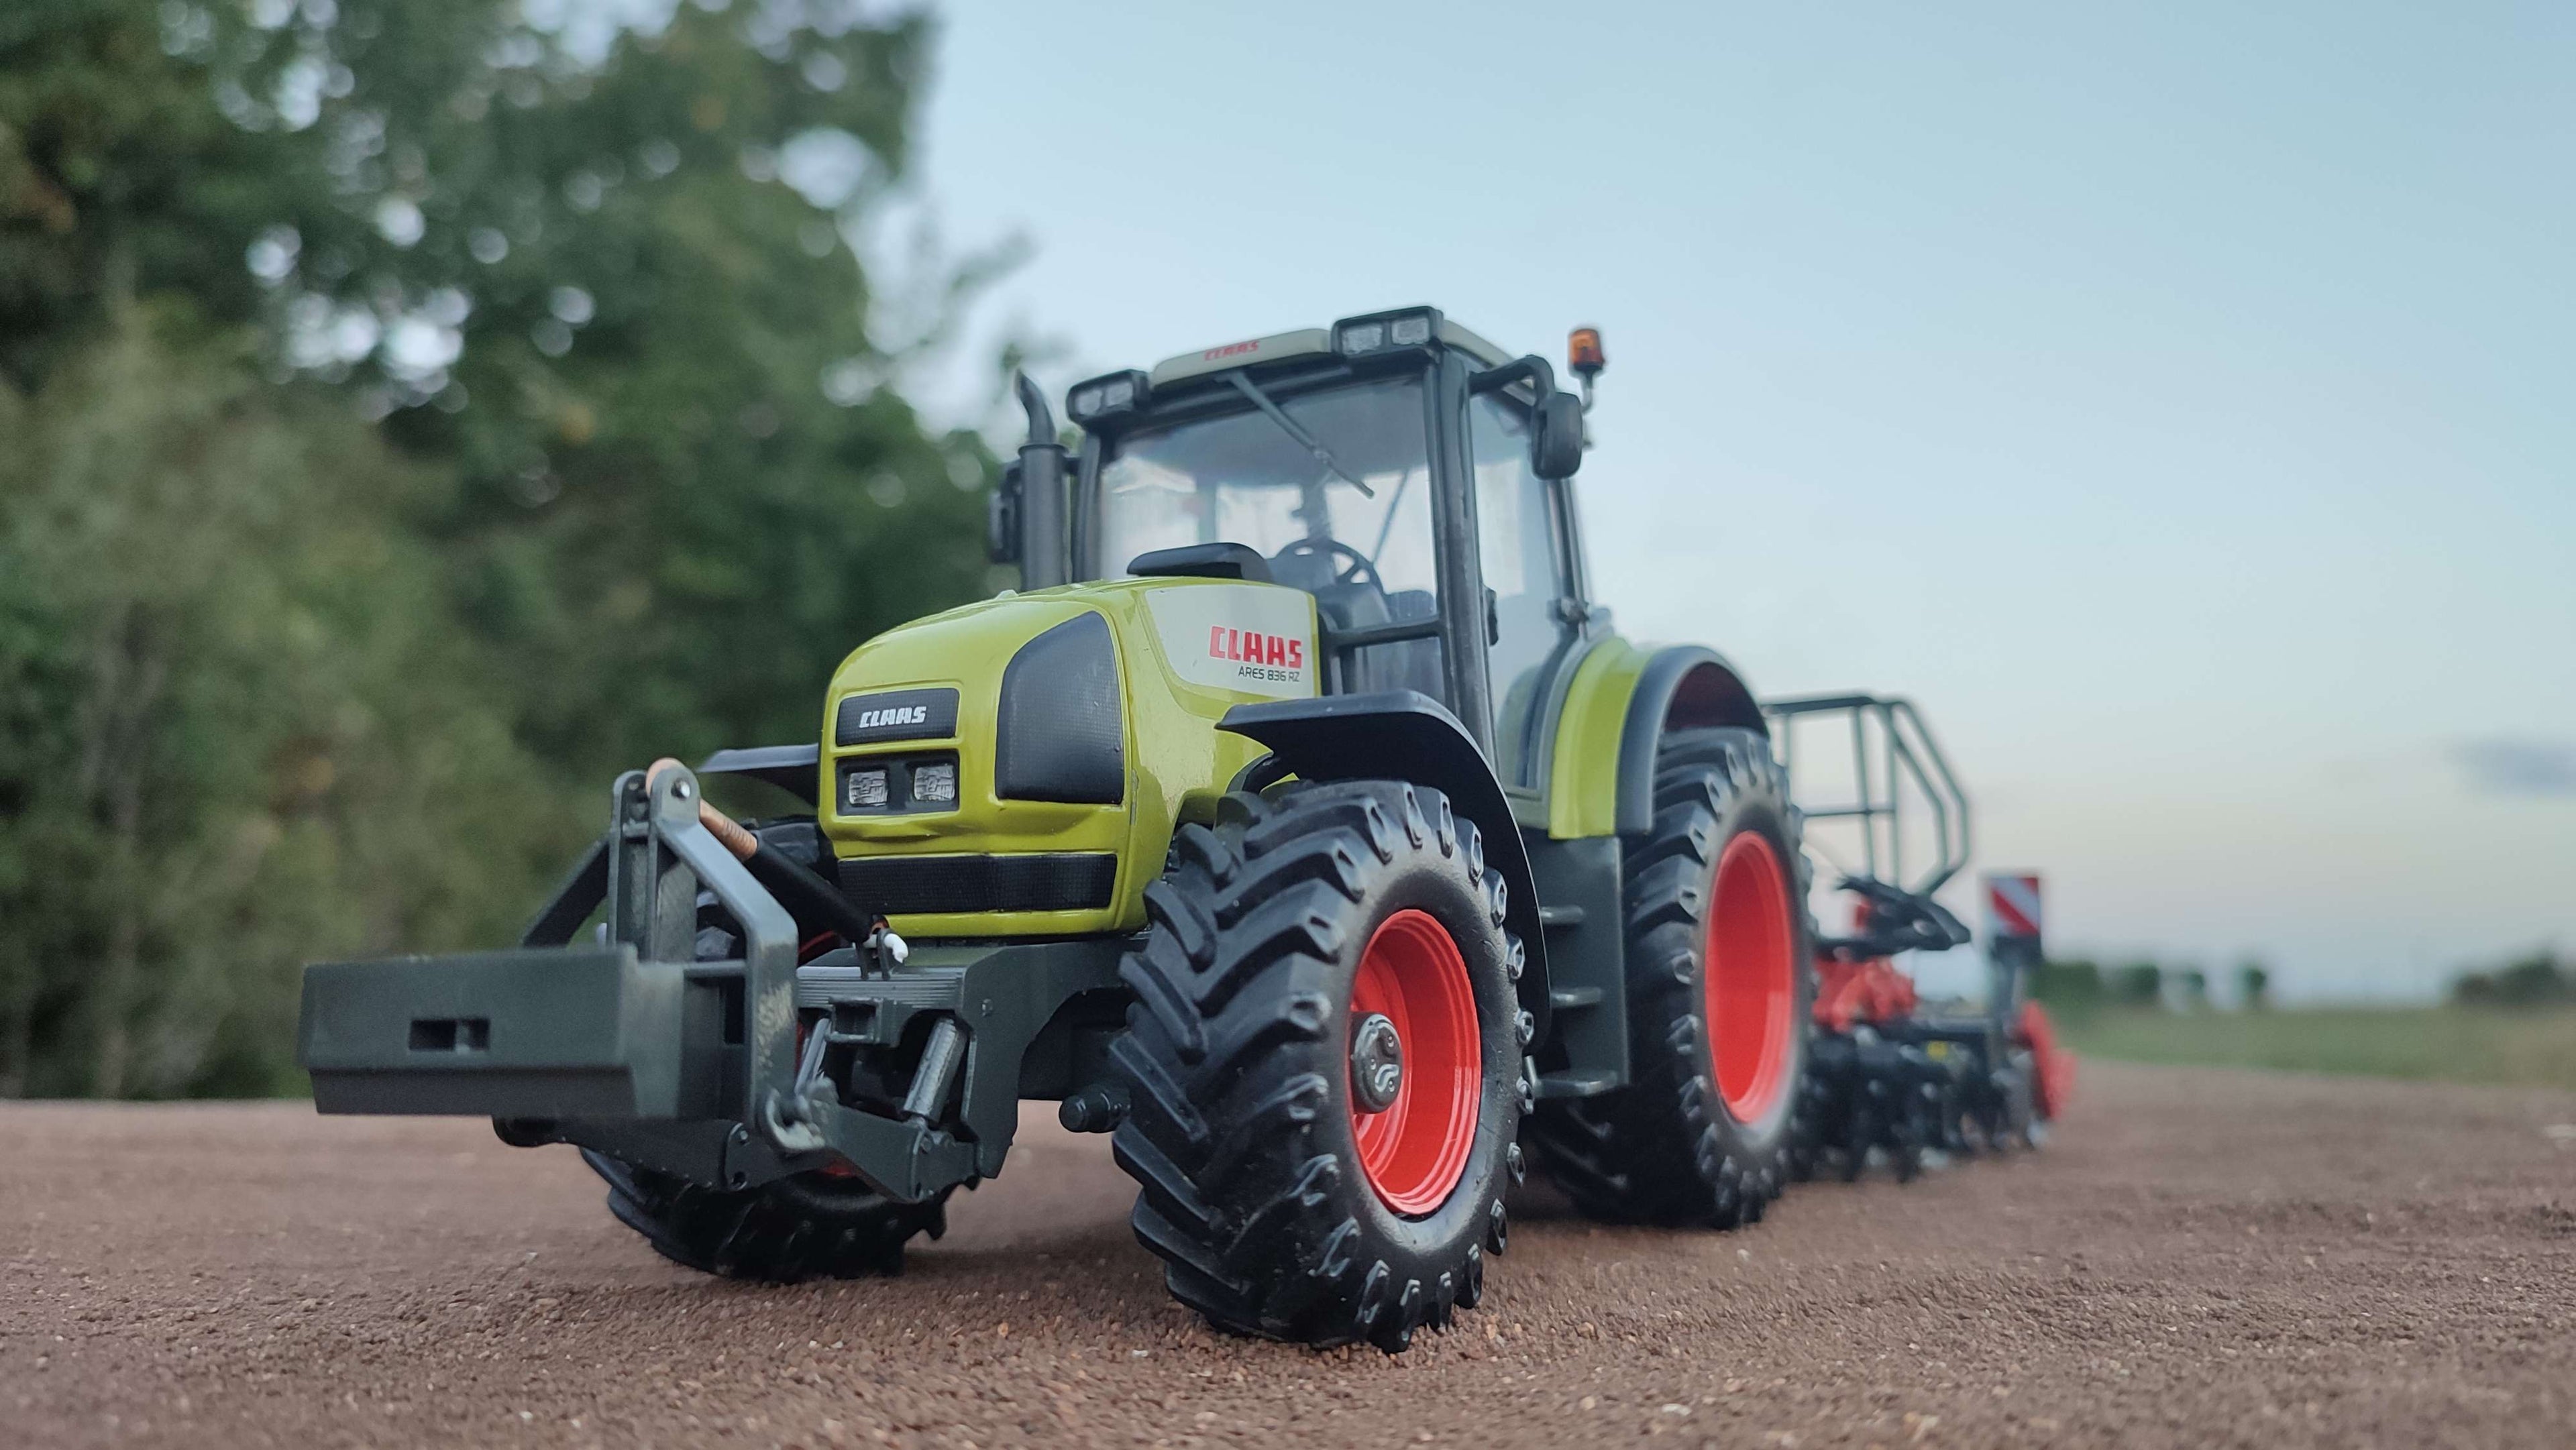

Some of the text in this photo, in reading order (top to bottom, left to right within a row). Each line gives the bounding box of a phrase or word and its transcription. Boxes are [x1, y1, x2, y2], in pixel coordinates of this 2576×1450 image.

[1204, 341, 1260, 361] CLAAS
[1210, 626, 1302, 669] CLAAS
[1238, 666, 1300, 682] ARES 836 RZ
[859, 706, 927, 728] CLAAS
